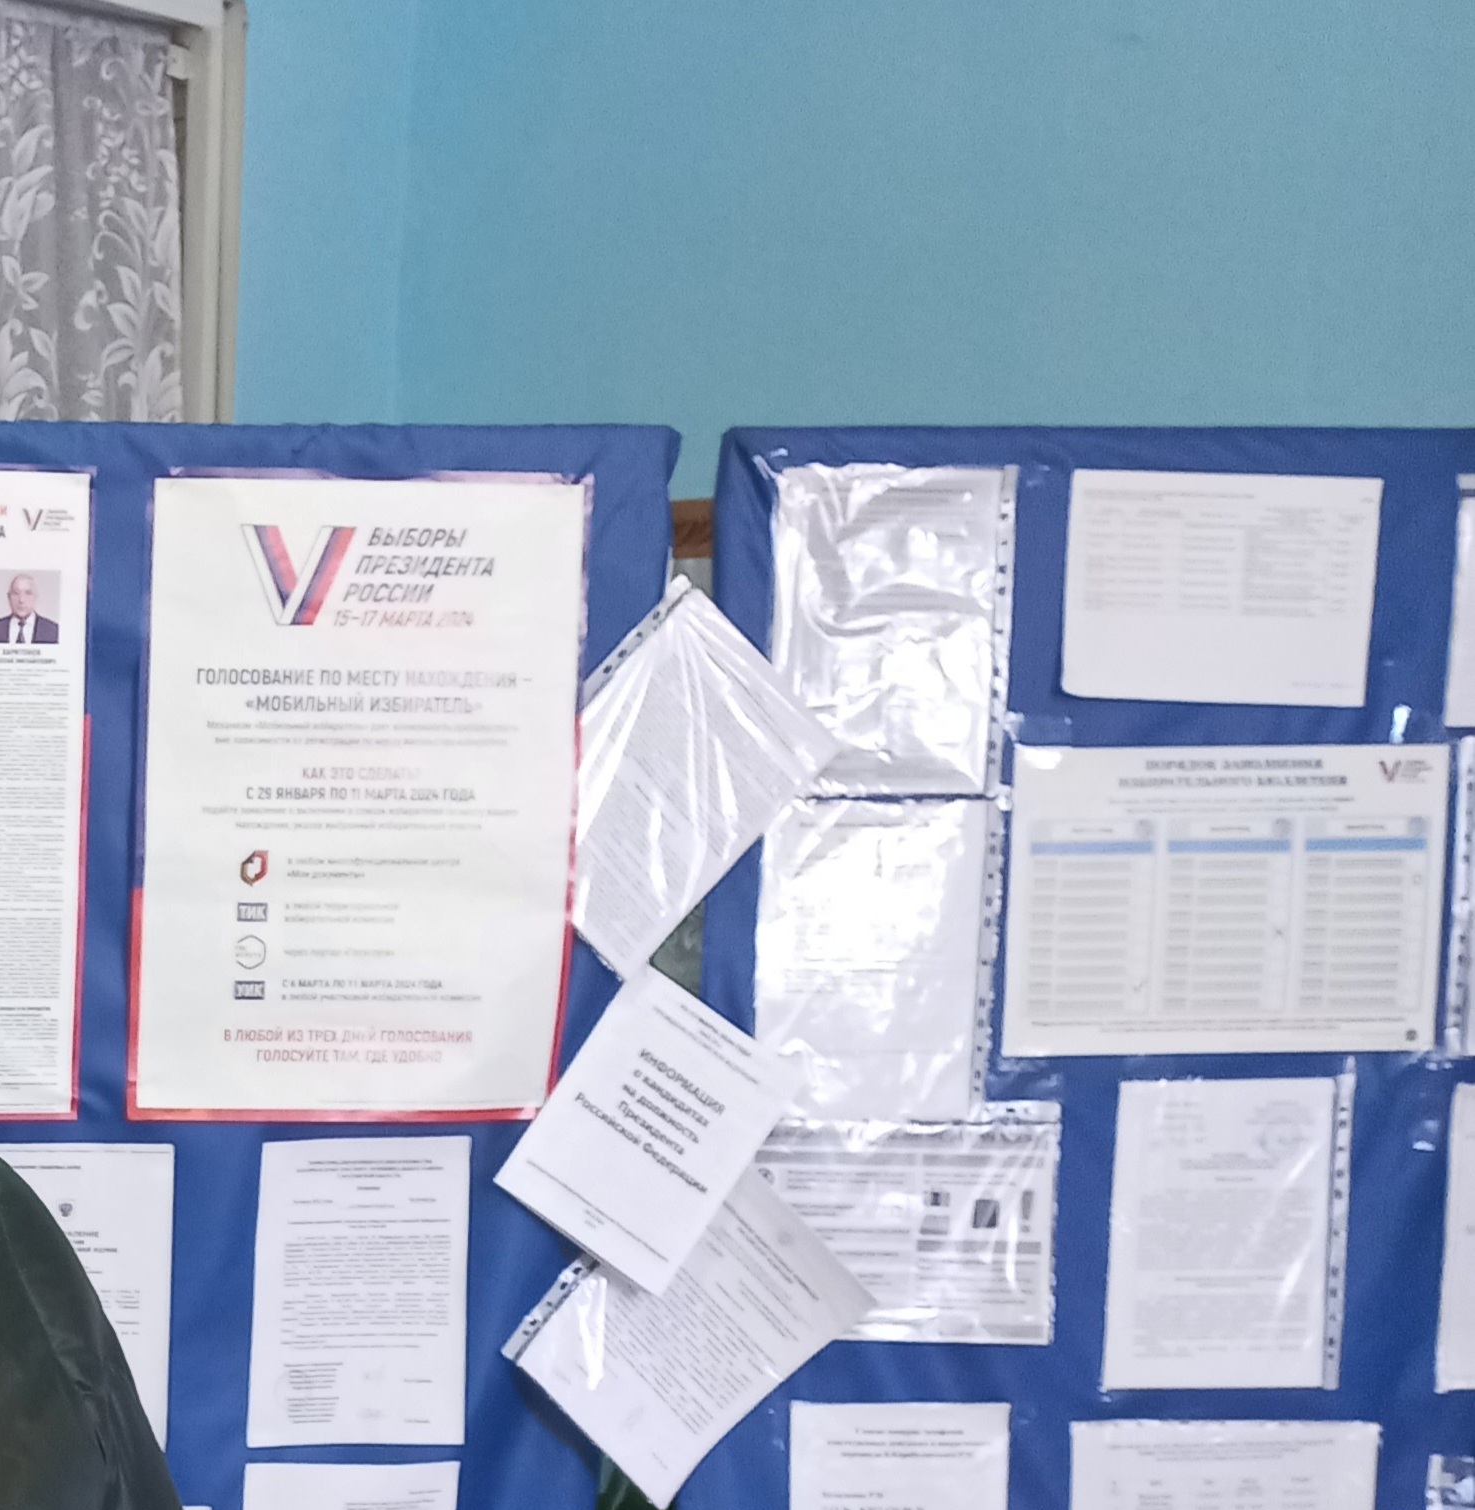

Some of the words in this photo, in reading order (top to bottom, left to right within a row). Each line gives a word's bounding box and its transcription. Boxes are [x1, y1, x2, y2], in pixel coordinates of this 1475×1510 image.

[368, 527, 468, 548] ВЫБОРЫ
[355, 555, 496, 578] ПРЕЗИДЕНТА
[343, 583, 434, 603] РОССИИ
[379, 610, 432, 628] МАРТА
[435, 611, 475, 628] 2024
[196, 668, 314, 686] ГОЛОСОВАНИЕ
[319, 669, 342, 686] ПО
[347, 670, 399, 687] МЕСТУ
[405, 671, 517, 689] НАХОЖДЕНИЯ
[245, 691, 364, 712] «МОБИЛЬНЫЙ
[369, 694, 482, 714] ИЗБИРАТЕЛЬ»
[302, 767, 326, 780] КАК
[330, 767, 353, 780] ЭТО
[246, 787, 254, 799] С
[257, 787, 272, 800] 29
[276, 787, 326, 800] ЯНВАРЯ
[330, 788, 347, 800] ПО
[364, 788, 407, 800] МАРТА
[410, 788, 438, 800] 2024
[442, 788, 476, 802] ГОДА
[239, 906, 265, 920] ТИК
[224, 1029, 231, 1042] В
[234, 1026, 283, 1043] ЛЮБОЙ
[287, 1030, 304, 1043] ИЗ
[308, 1030, 337, 1043] ТРЕХ
[341, 1028, 376, 1044] ДНЕЙ
[380, 1030, 472, 1044] ГОЛОСОВАНИЯ
[256, 1047, 329, 1063] ГОЛОСУЙТЕ
[365, 1050, 388, 1065] ГДЕ
[392, 1050, 443, 1064] УДОБНО
[638, 1047, 725, 1116] ИНФОРМАЦИЯ
[643, 1073, 710, 1129] кандидатах
[621, 1082, 636, 1099] на
[637, 1091, 700, 1145] должность
[617, 1099, 686, 1157] Президента
[574, 1090, 643, 1147] Российской
[642, 1140, 708, 1195] Федерации
